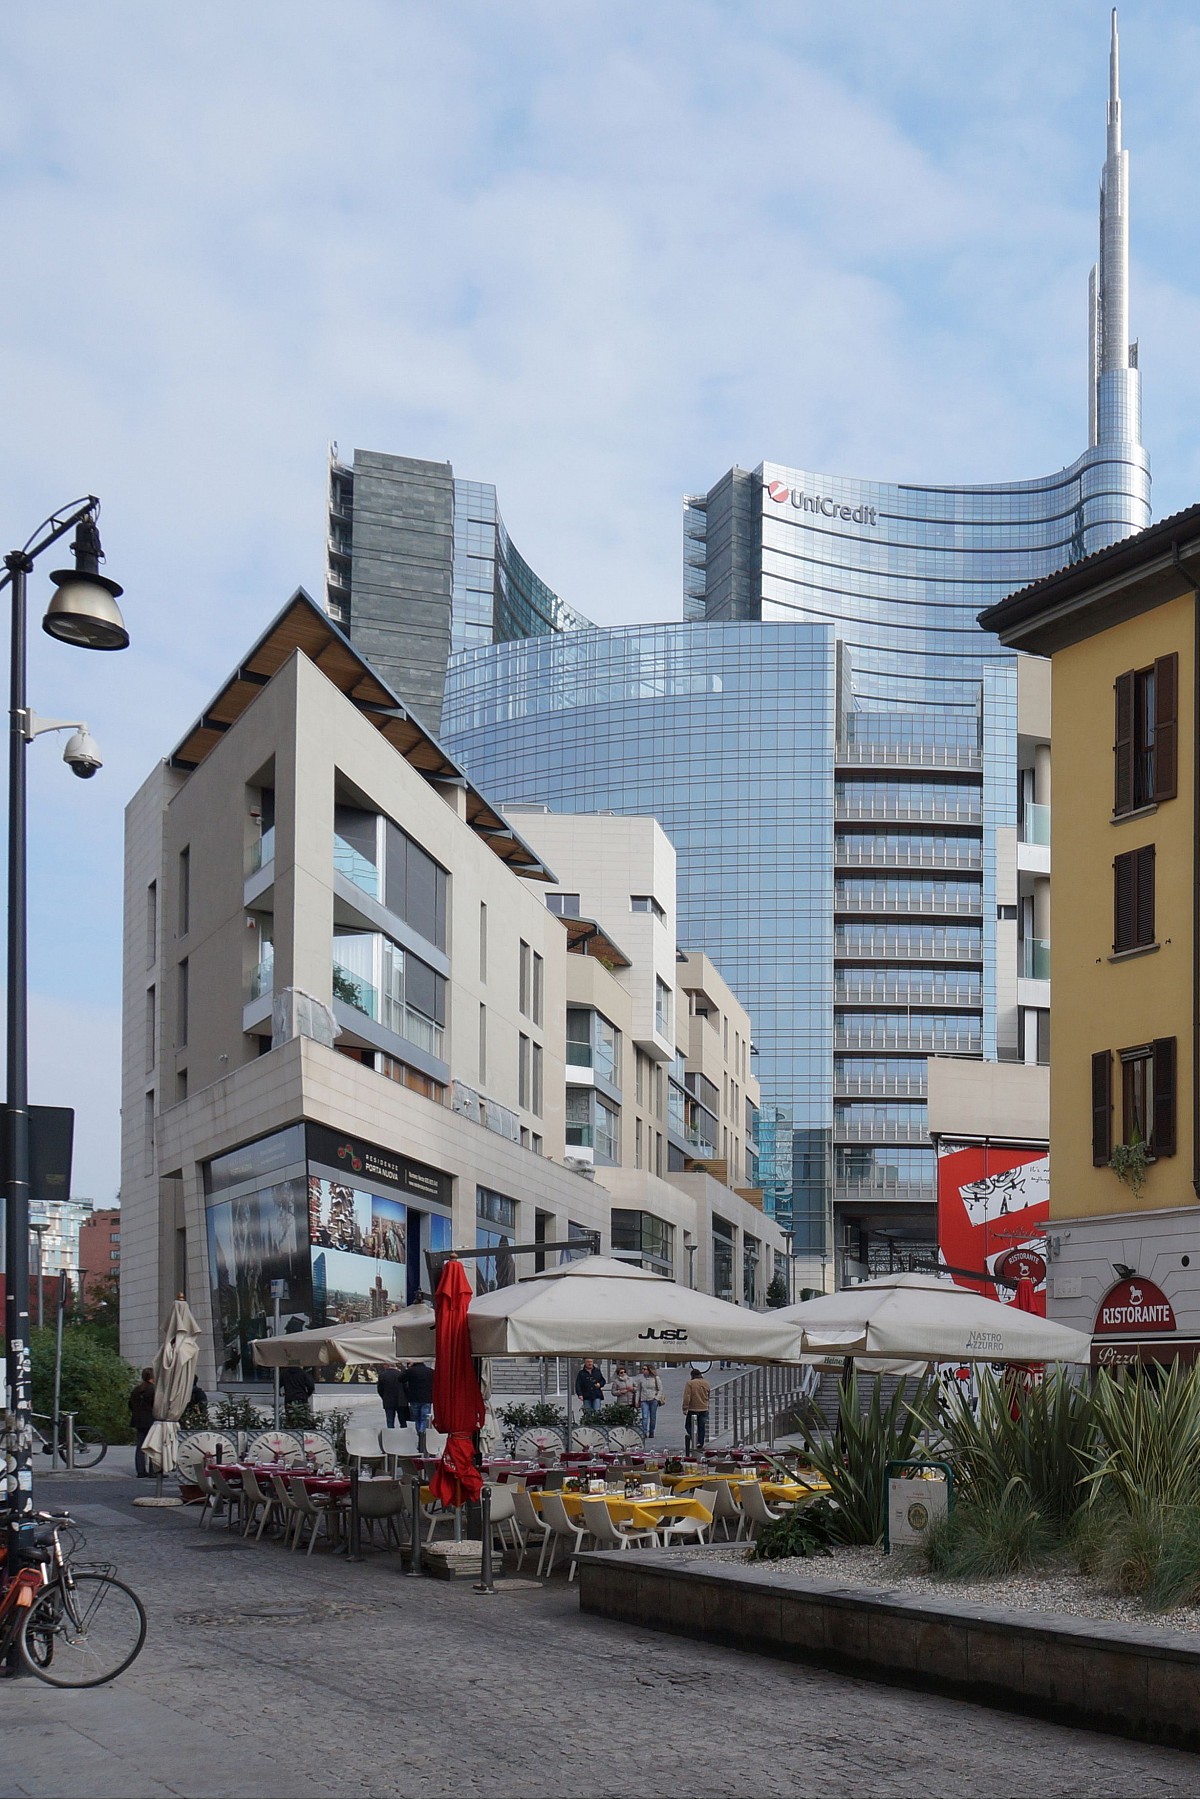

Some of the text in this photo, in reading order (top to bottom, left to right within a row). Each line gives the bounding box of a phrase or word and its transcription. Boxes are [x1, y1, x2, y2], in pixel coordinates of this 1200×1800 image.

[790, 488, 877, 526] UniCredit
[365, 1154, 399, 1171] RESIDENZE
[365, 1162, 382, 1174] PORTA
[382, 1168, 399, 1181] NUOVA
[1008, 1252, 1040, 1265] RISTORANTE
[1103, 1304, 1170, 1324] RISTORANTE
[966, 1340, 1004, 1351] AZZURRO
[824, 1356, 844, 1365] Heine
[1097, 1347, 1139, 1365] Pizza
